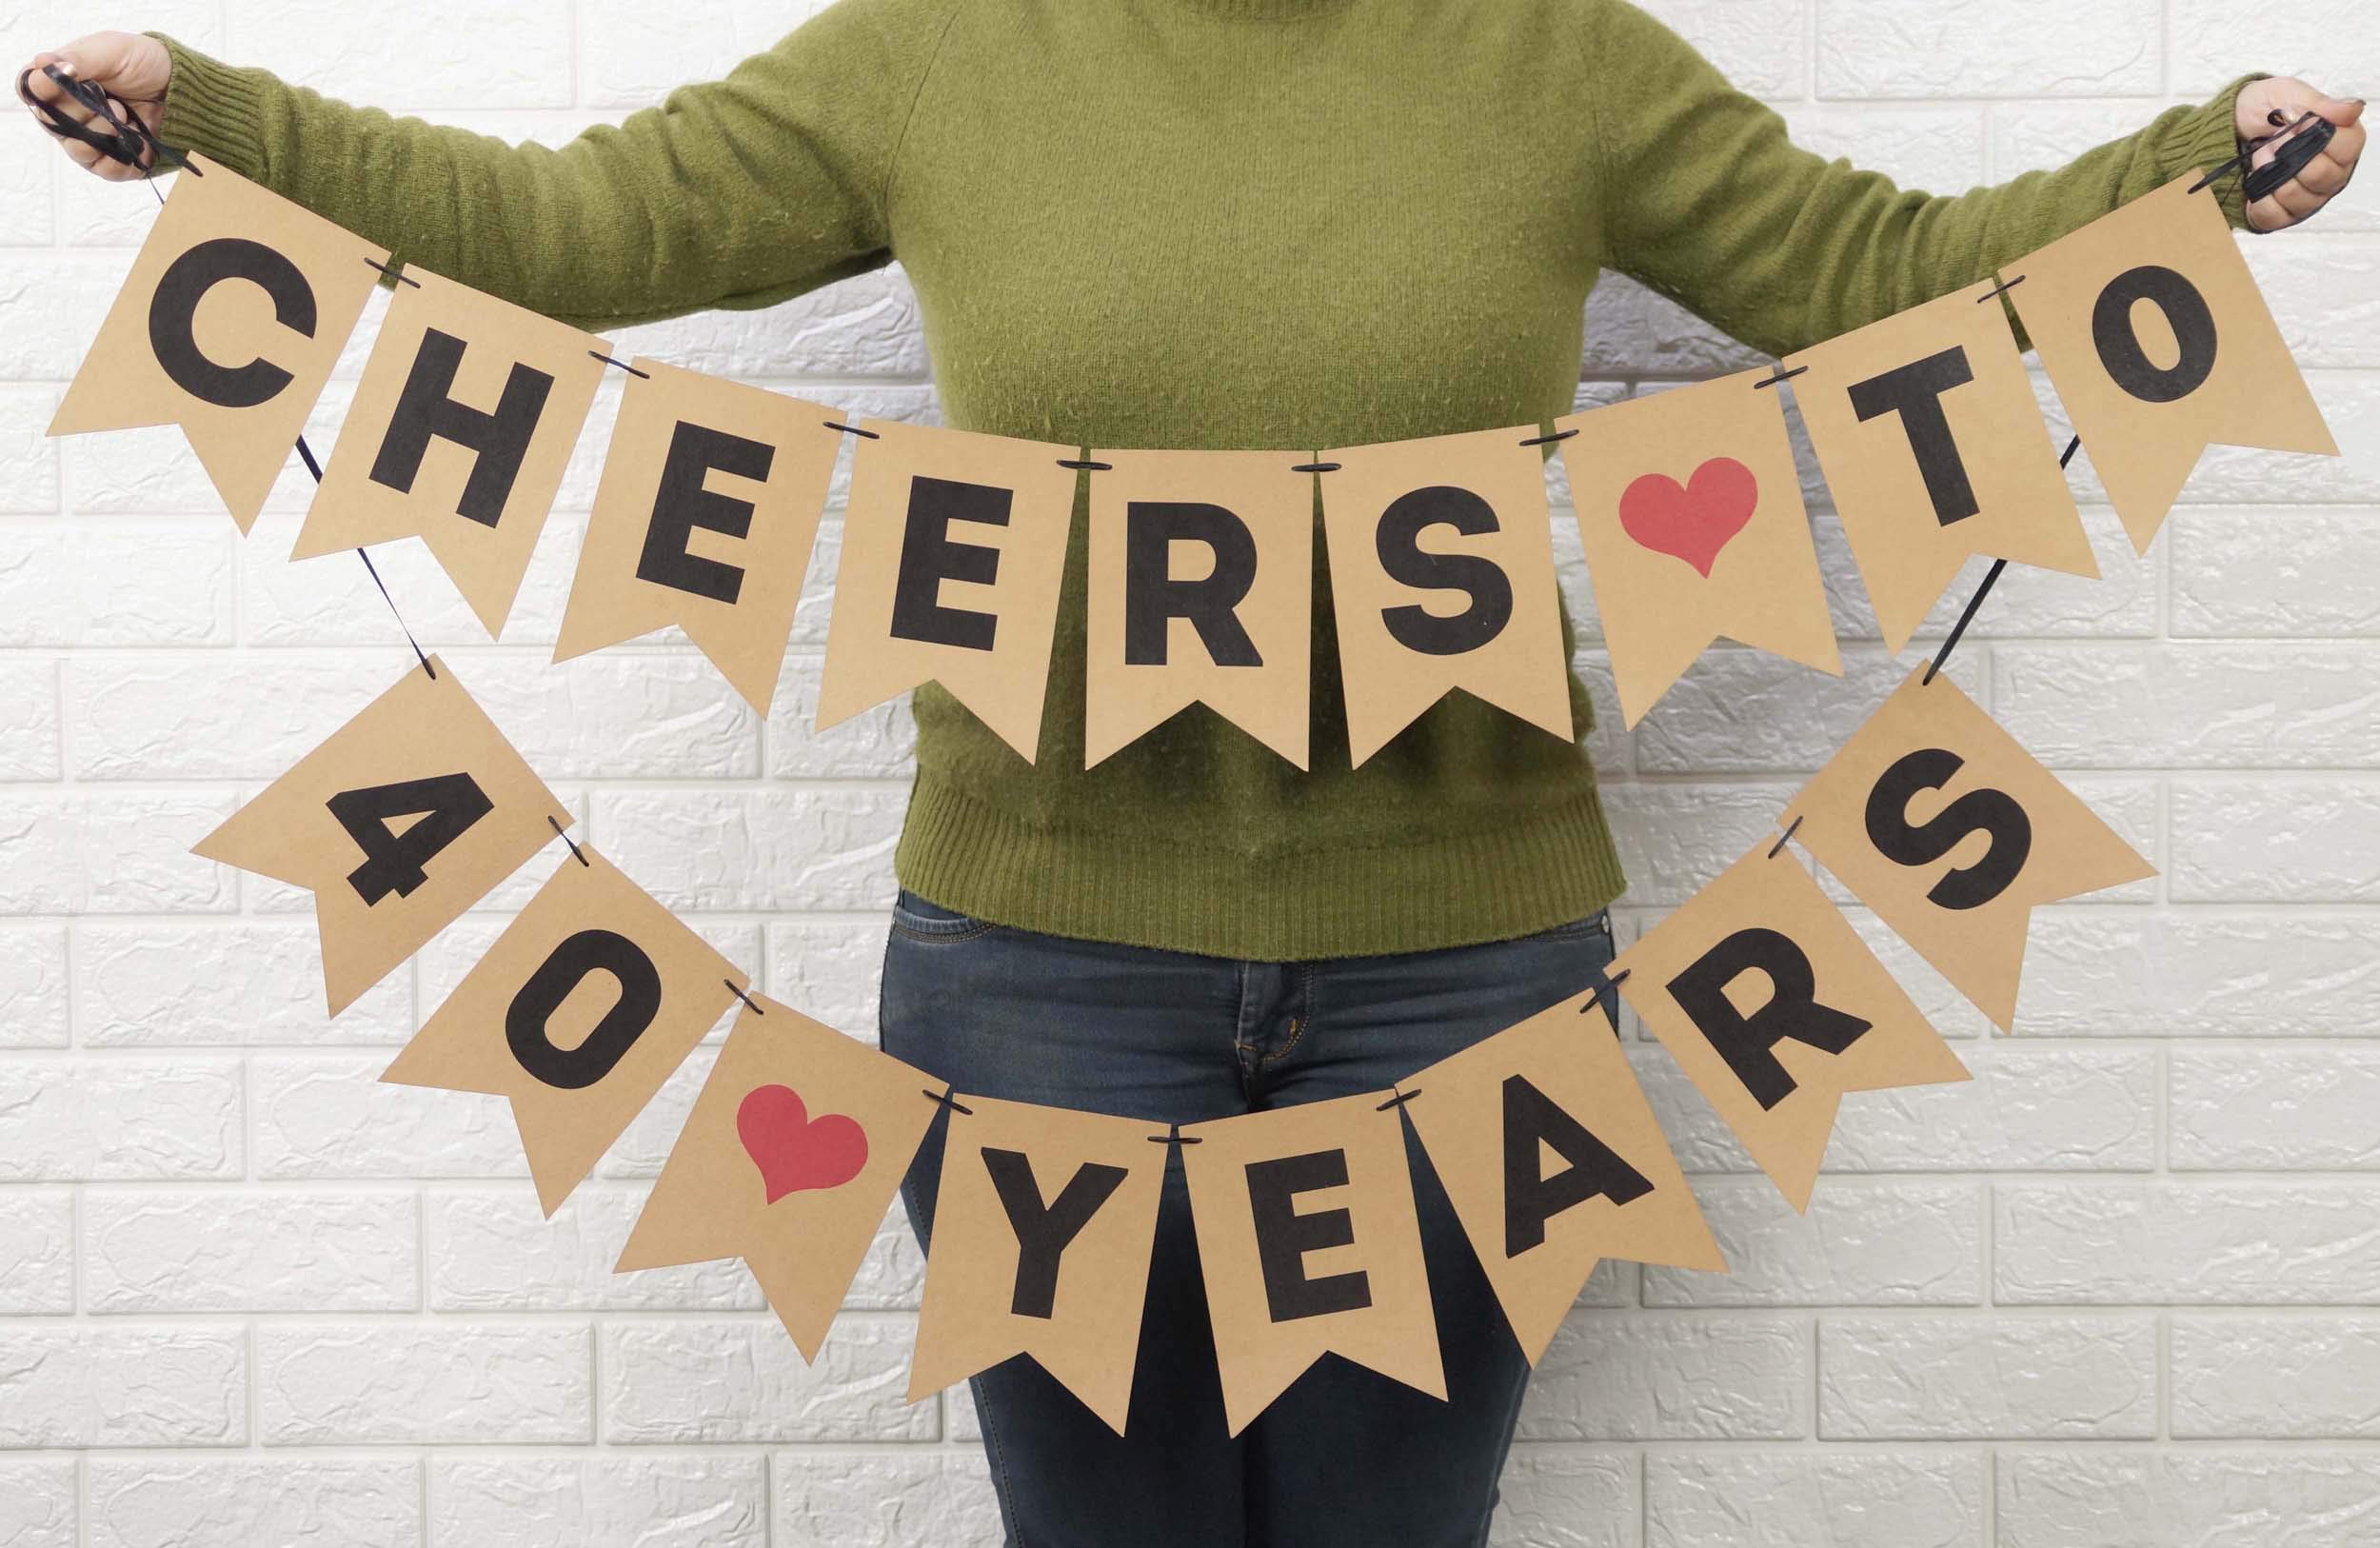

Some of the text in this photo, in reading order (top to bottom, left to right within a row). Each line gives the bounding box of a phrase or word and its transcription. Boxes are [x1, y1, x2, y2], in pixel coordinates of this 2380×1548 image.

[148, 237, 2218, 667] CHEERS TO
[325, 747, 2033, 1323] 40 YEARS
